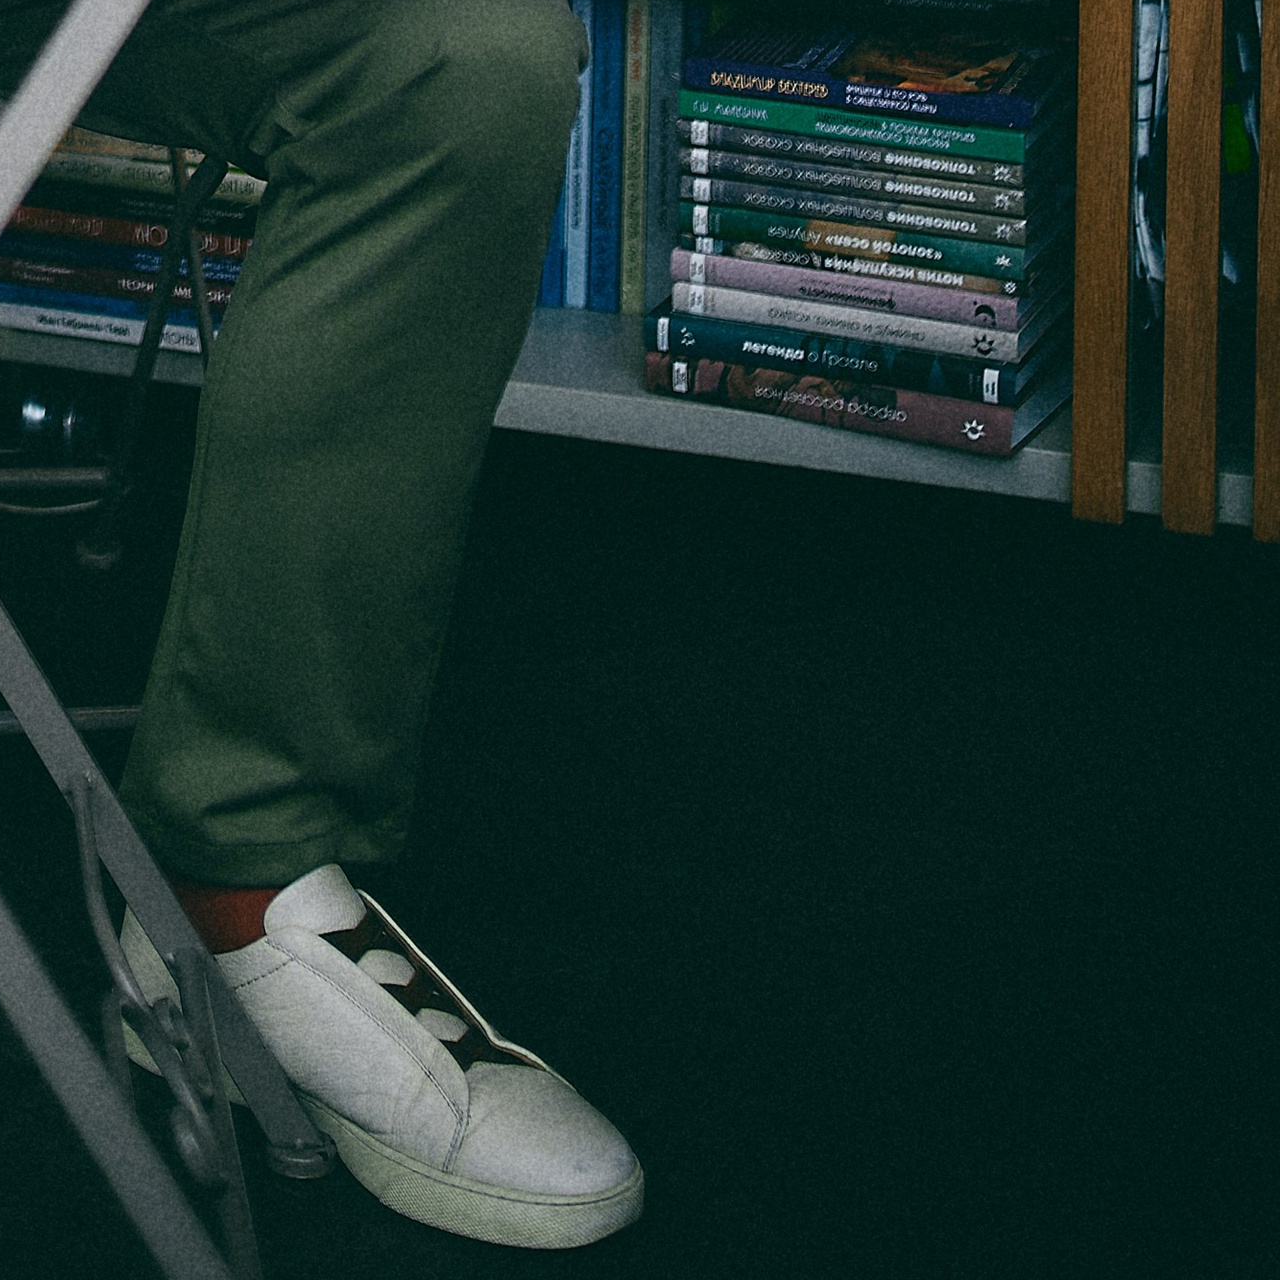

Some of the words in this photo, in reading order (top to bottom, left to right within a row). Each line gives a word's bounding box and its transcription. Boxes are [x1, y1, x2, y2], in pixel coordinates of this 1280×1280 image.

[795, 140, 882, 164] волшебных
[885, 152, 976, 175] толкование
[795, 169, 882, 193] волшебных
[885, 180, 976, 204] толкование
[797, 199, 884, 223] волшебных
[887, 210, 978, 234] толкование
[741, 341, 805, 362] легенда
[807, 352, 819, 363] о
[820, 351, 879, 373] Граале
